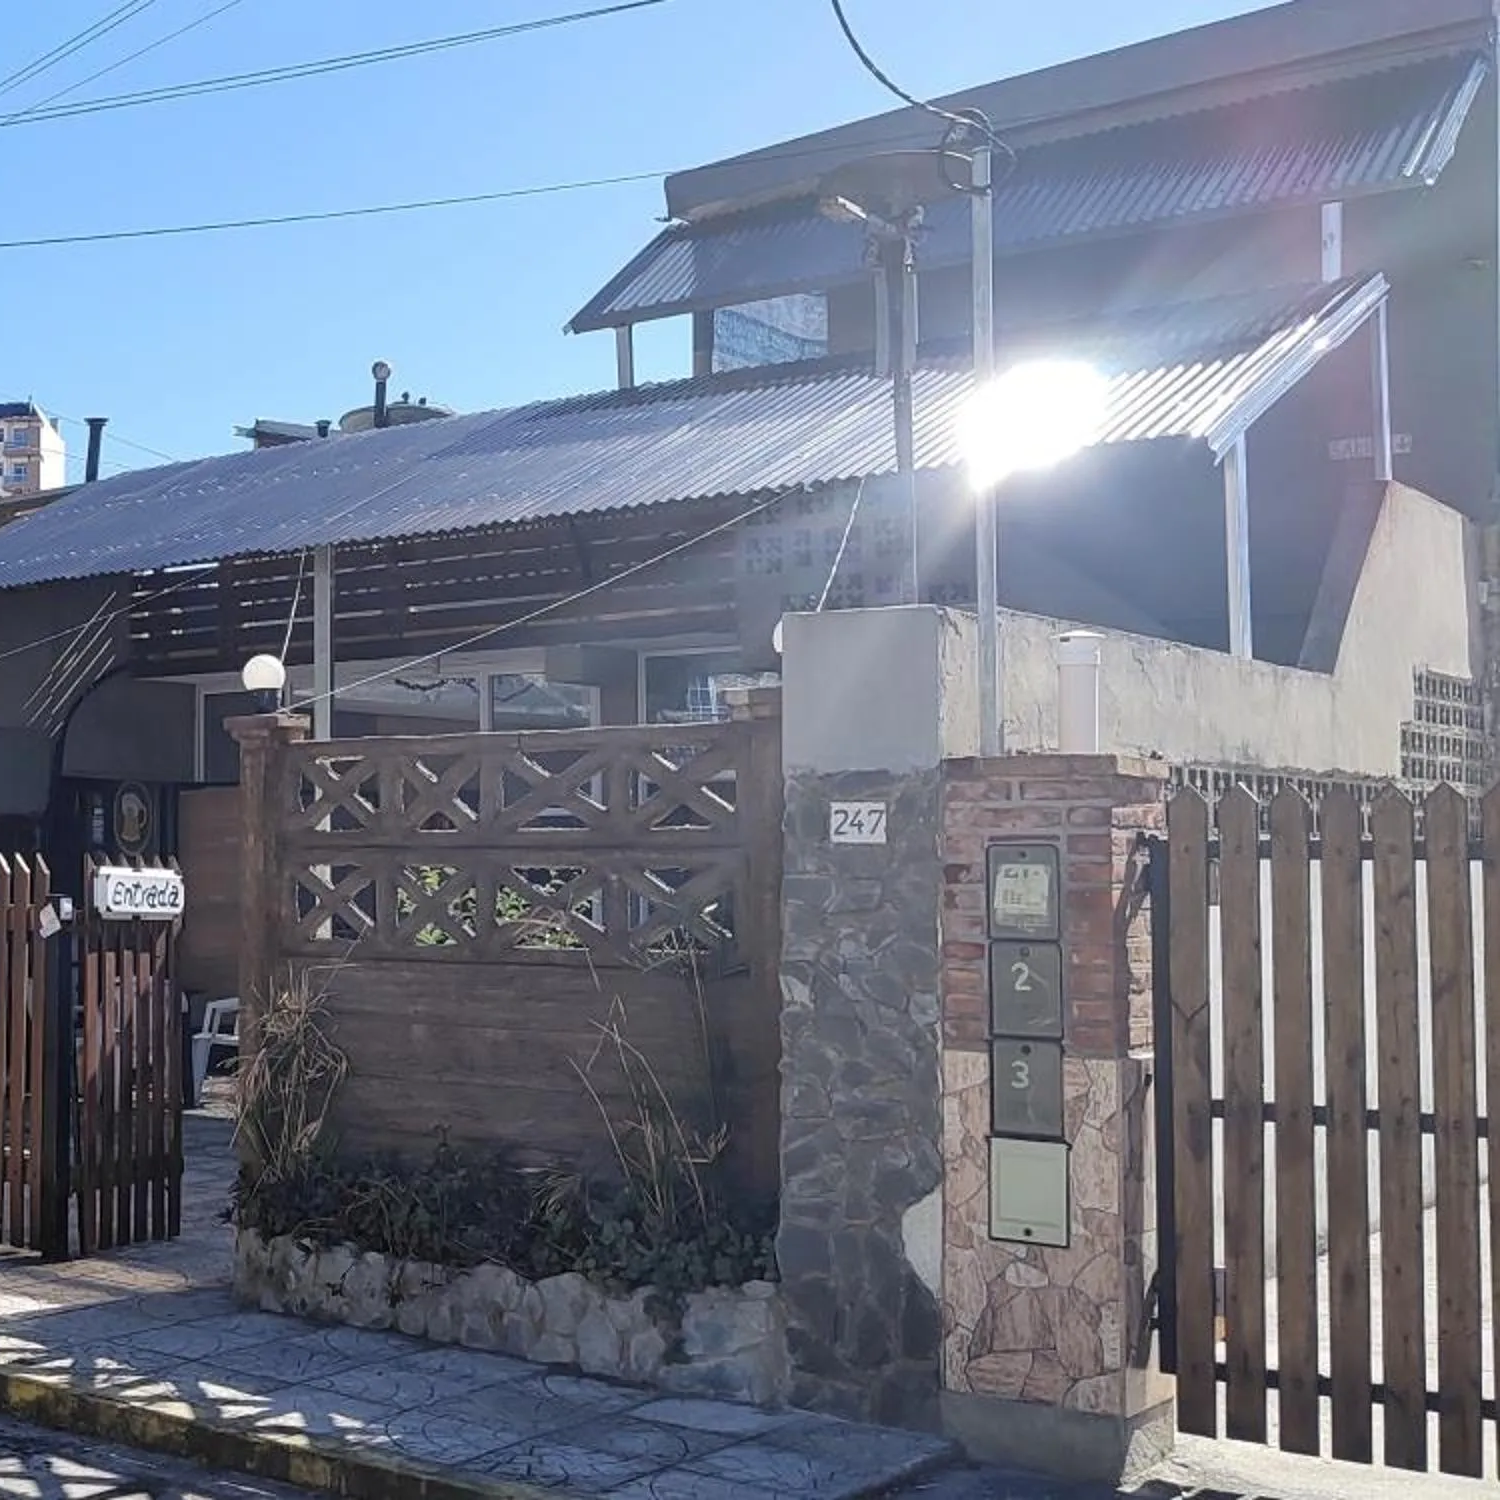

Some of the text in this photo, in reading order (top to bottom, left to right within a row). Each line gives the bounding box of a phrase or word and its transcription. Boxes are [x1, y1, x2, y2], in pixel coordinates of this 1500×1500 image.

[833, 808, 885, 835] 247
[111, 880, 180, 908] Entrada
[1011, 961, 1032, 992] 2
[1011, 1060, 1030, 1089] 3
